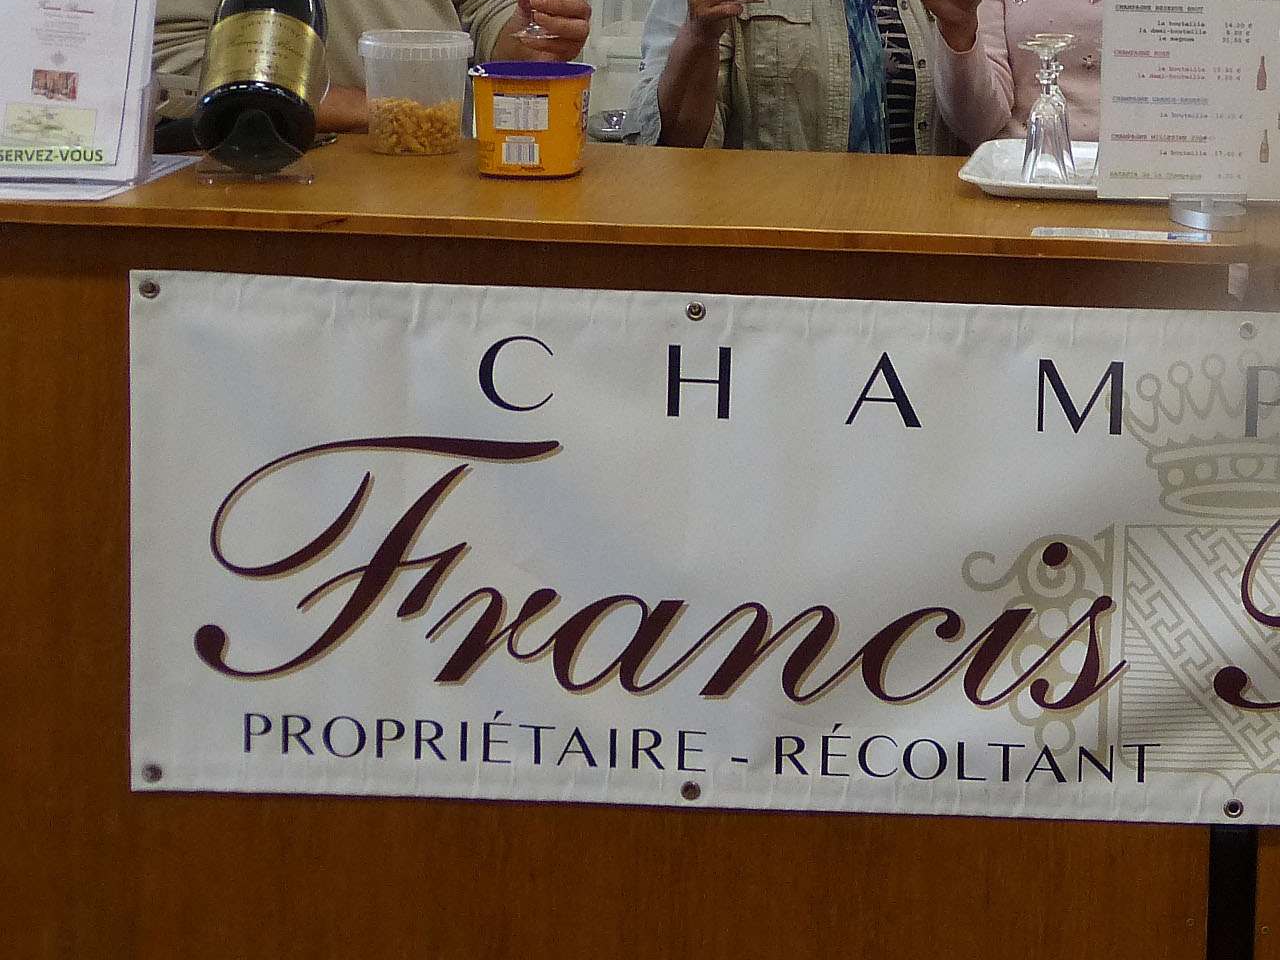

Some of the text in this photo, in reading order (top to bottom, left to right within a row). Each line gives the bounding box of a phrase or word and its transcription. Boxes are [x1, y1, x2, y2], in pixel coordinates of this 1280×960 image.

[193, 435, 1130, 713] Francis
[242, 710, 706, 774] PROPRIÉTAIRE
[775, 722, 1161, 785] RÉCOLTANT
